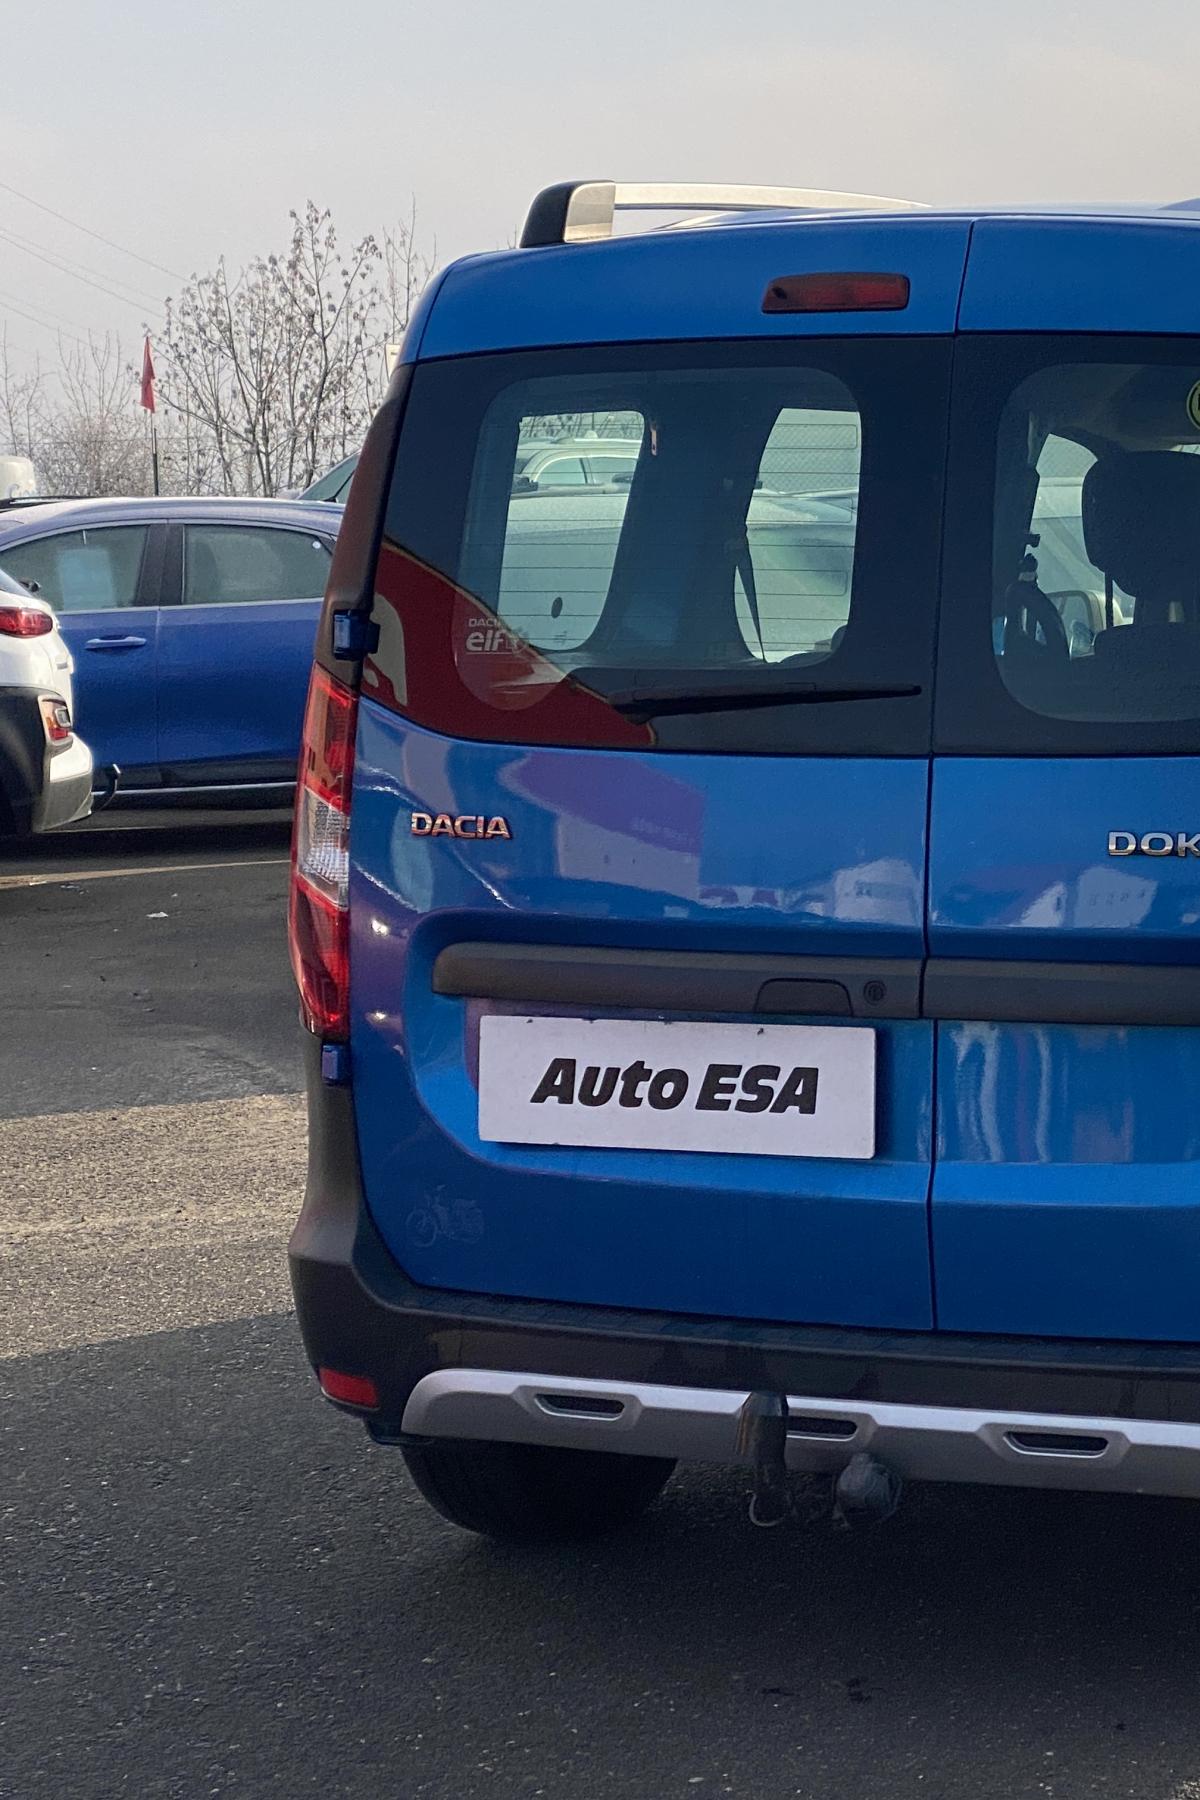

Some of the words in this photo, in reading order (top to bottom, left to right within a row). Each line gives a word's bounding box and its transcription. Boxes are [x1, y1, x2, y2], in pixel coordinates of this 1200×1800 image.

[466, 629, 508, 652] elf
[411, 812, 511, 839] DACIA
[530, 1057, 690, 1111] Auto
[694, 1062, 820, 1116] ESA
